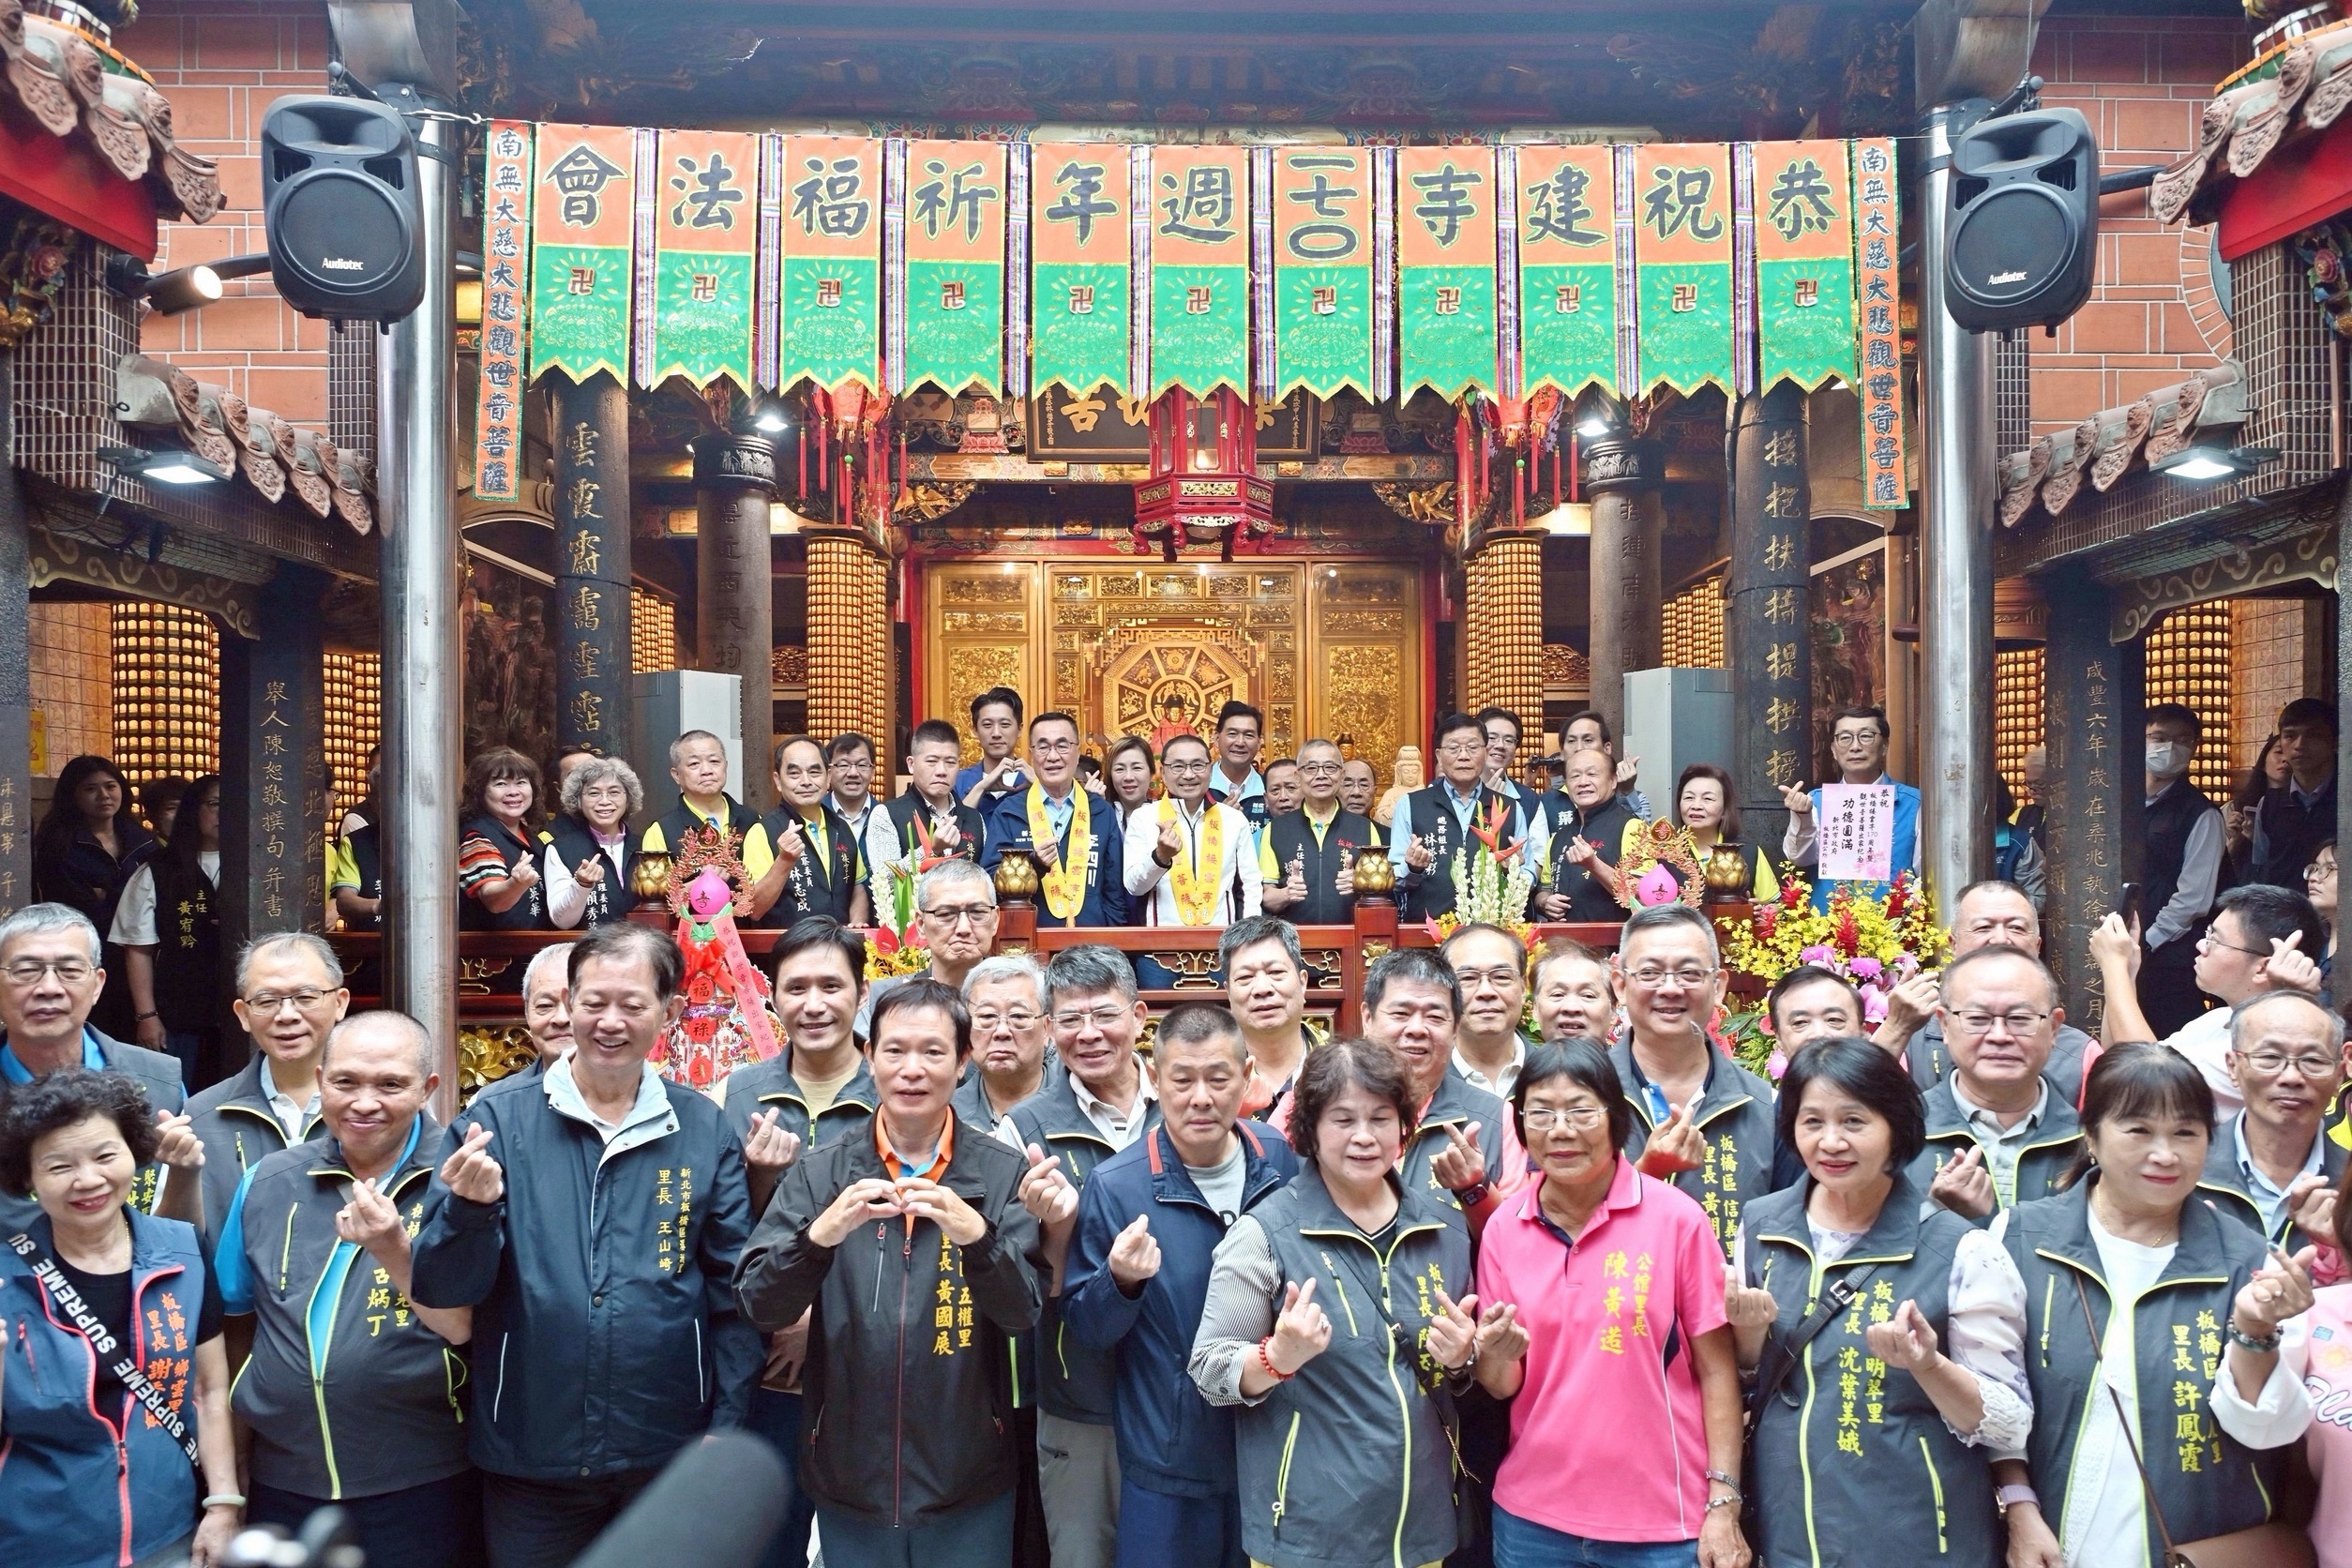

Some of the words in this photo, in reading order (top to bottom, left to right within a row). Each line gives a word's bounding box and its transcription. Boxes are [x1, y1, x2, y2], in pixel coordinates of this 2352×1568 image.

[322, 257, 364, 270] Audiotec
[1987, 271, 2028, 285] Audiotec
[479, 128, 523, 496] 南無大慈大悲觀世音菩薩
[1861, 145, 1901, 505] 南無大慈大悲觀世音菩薩
[1841, 797, 1855, 851] 功德圓滿
[1879, 788, 1890, 808] 恭祝
[1202, 819, 1219, 903] 板橋接雲寺
[1437, 815, 1447, 855] 總務組長
[195, 889, 208, 913] 主任
[597, 880, 609, 915] 理委員
[790, 867, 810, 912] 林志成
[693, 983, 710, 997] 福
[656, 1169, 674, 1205] 里長
[1701, 1145, 1719, 1184] 里長
[1720, 1134, 1739, 1192] 板橋區
[657, 1221, 673, 1272] 王山崎
[938, 1231, 955, 1272] 里長
[1723, 1199, 1739, 1259] 信義里
[32, 1258, 117, 1354] SUPREME
[932, 1278, 956, 1356] 黃國展
[957, 1286, 974, 1348] 五權里
[1416, 1275, 1435, 1318] 里長
[1632, 1252, 1654, 1337] 公館里長
[1845, 1291, 1868, 1335] 里長
[146, 1310, 171, 1352] 里長
[161, 1292, 188, 1352] 板橋區
[2172, 1324, 2198, 1372] 里長
[2195, 1309, 2223, 1380] 板橋區
[113, 1357, 186, 1440] SUPREME
[1836, 1346, 1864, 1457] 沈葉美娥
[1864, 1357, 1886, 1425] 明翠里
[2172, 1380, 2207, 1473] 許鳳霞
